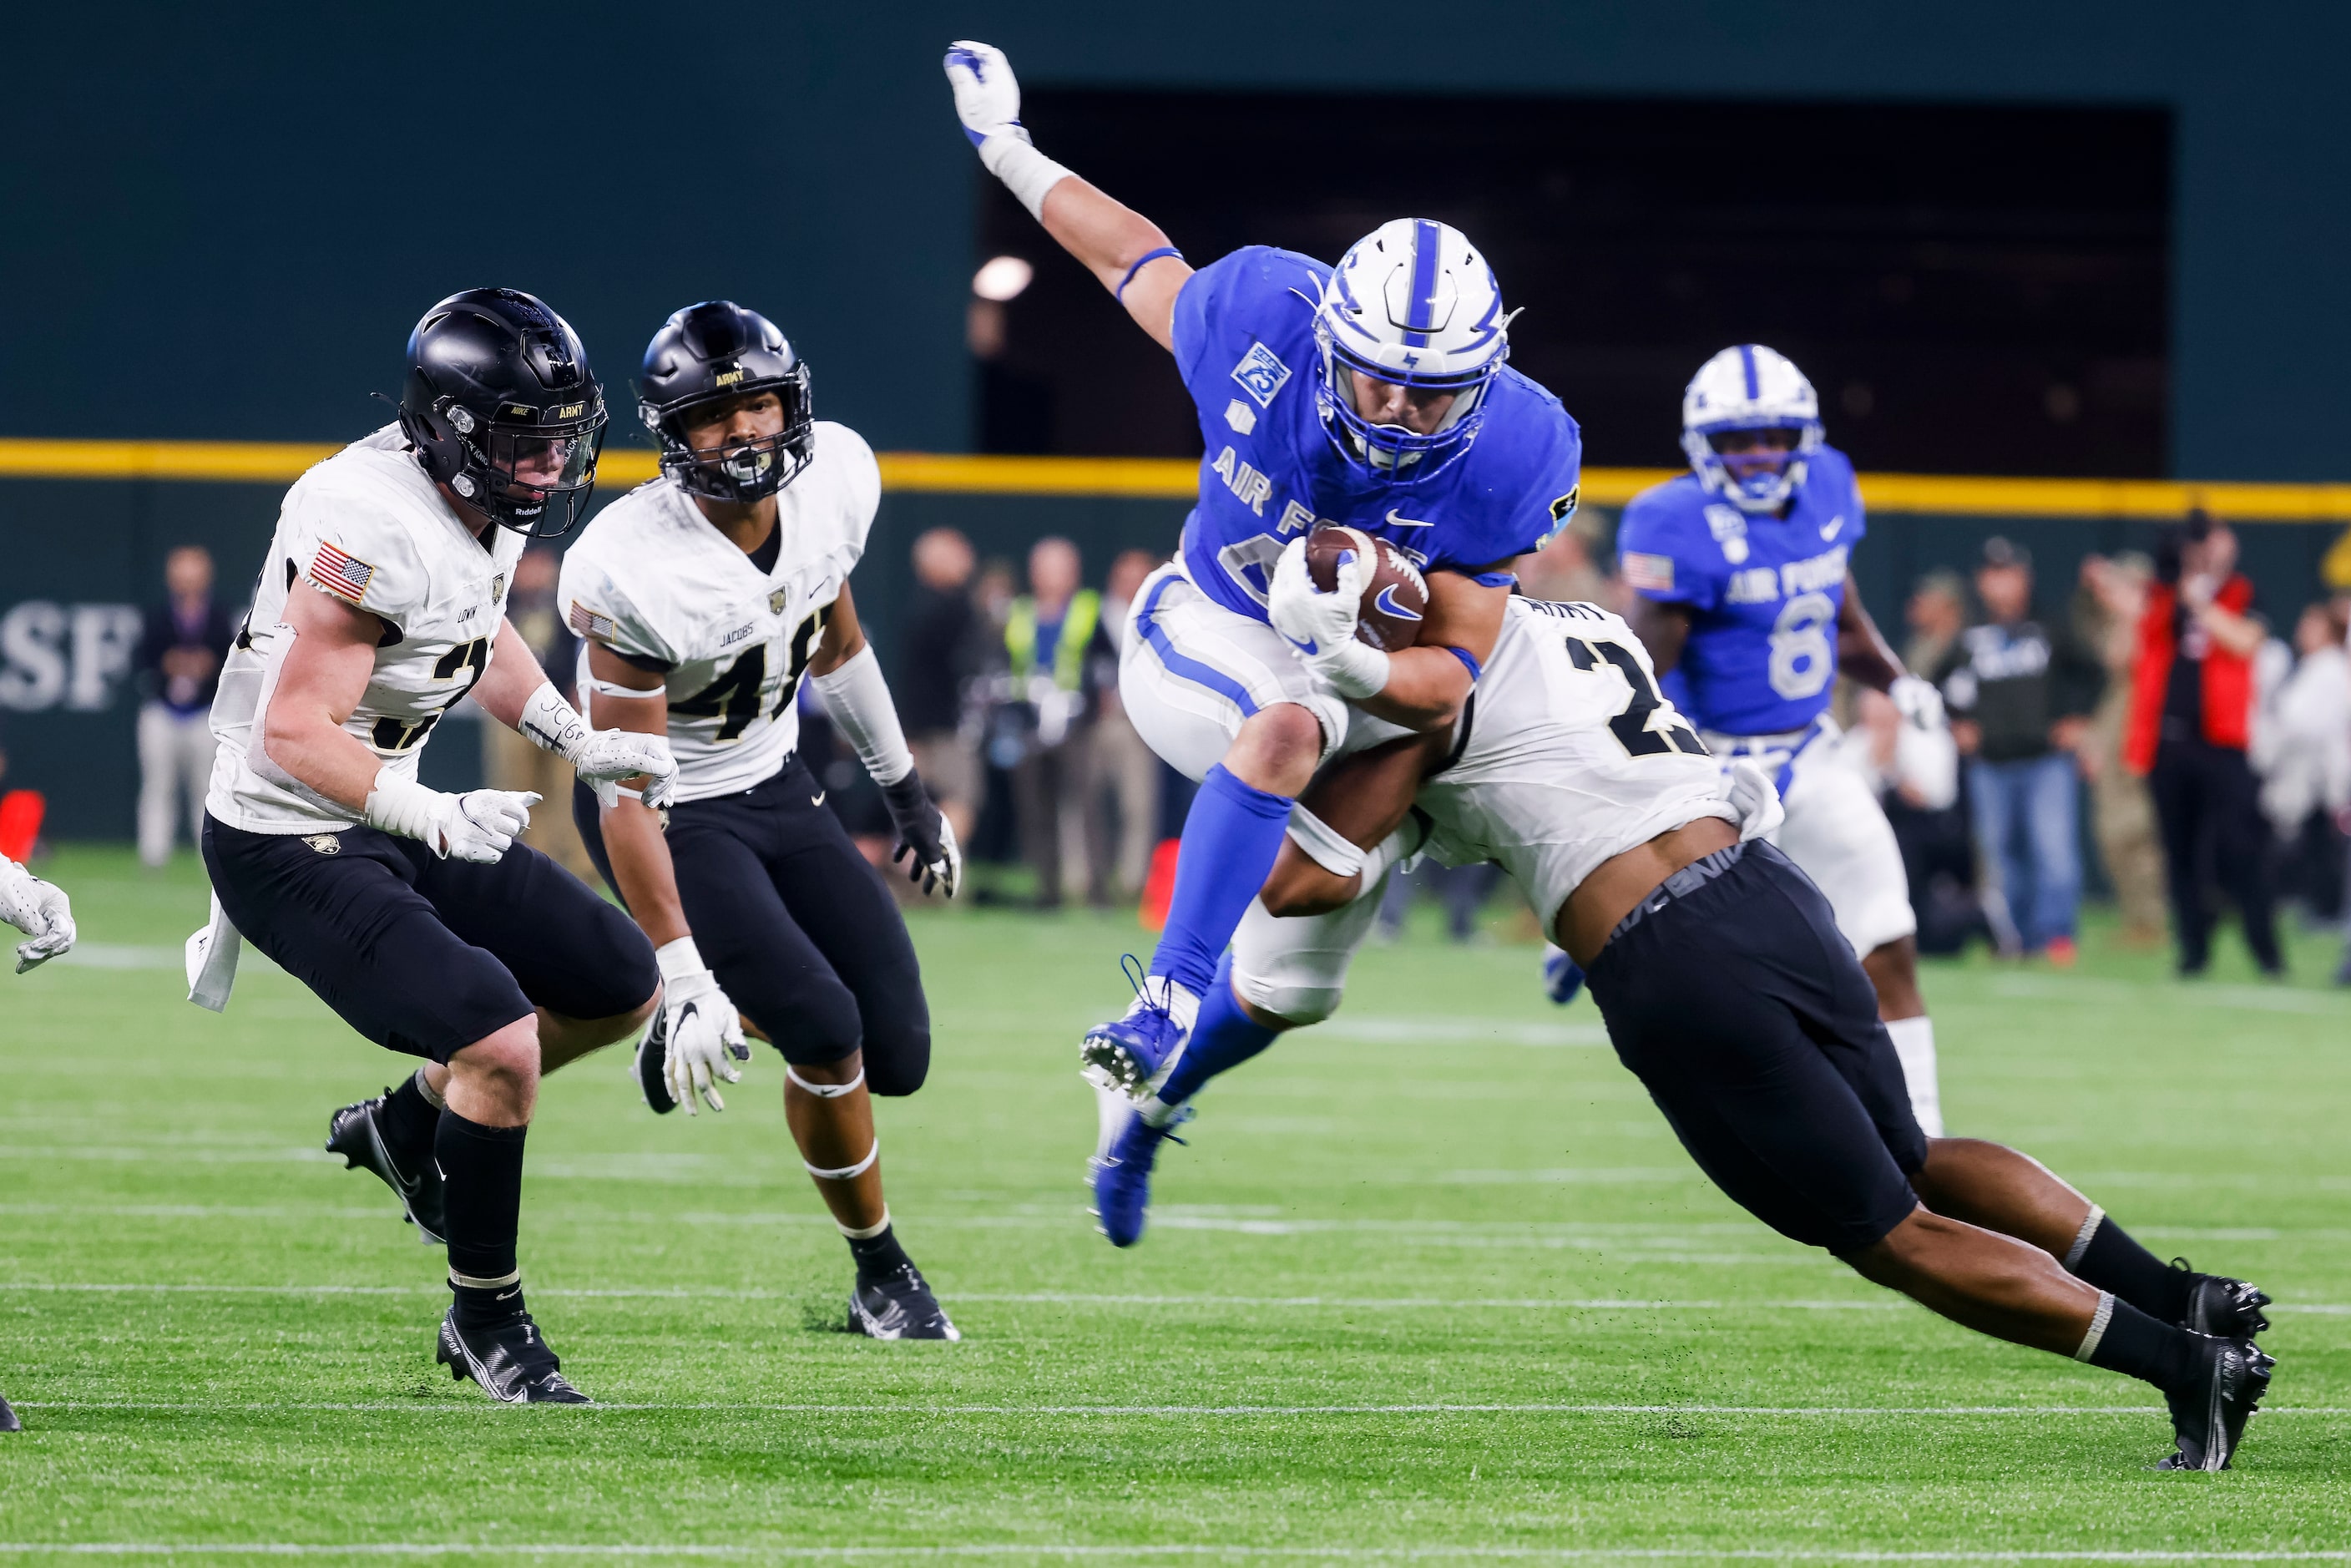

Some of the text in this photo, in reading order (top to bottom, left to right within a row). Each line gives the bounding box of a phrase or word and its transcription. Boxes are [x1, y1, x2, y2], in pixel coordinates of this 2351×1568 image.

[715, 370, 744, 387] ARMY
[510, 406, 530, 416] NIKE
[559, 404, 584, 419] ARMY
[473, 446, 488, 467] KNIG
[1211, 445, 1273, 518] AIR
[515, 506, 542, 516] Riddell
[1725, 566, 1780, 605] AIR
[457, 604, 478, 624] LOWIN
[720, 621, 754, 648] JACOBS
[368, 633, 494, 756] 3
